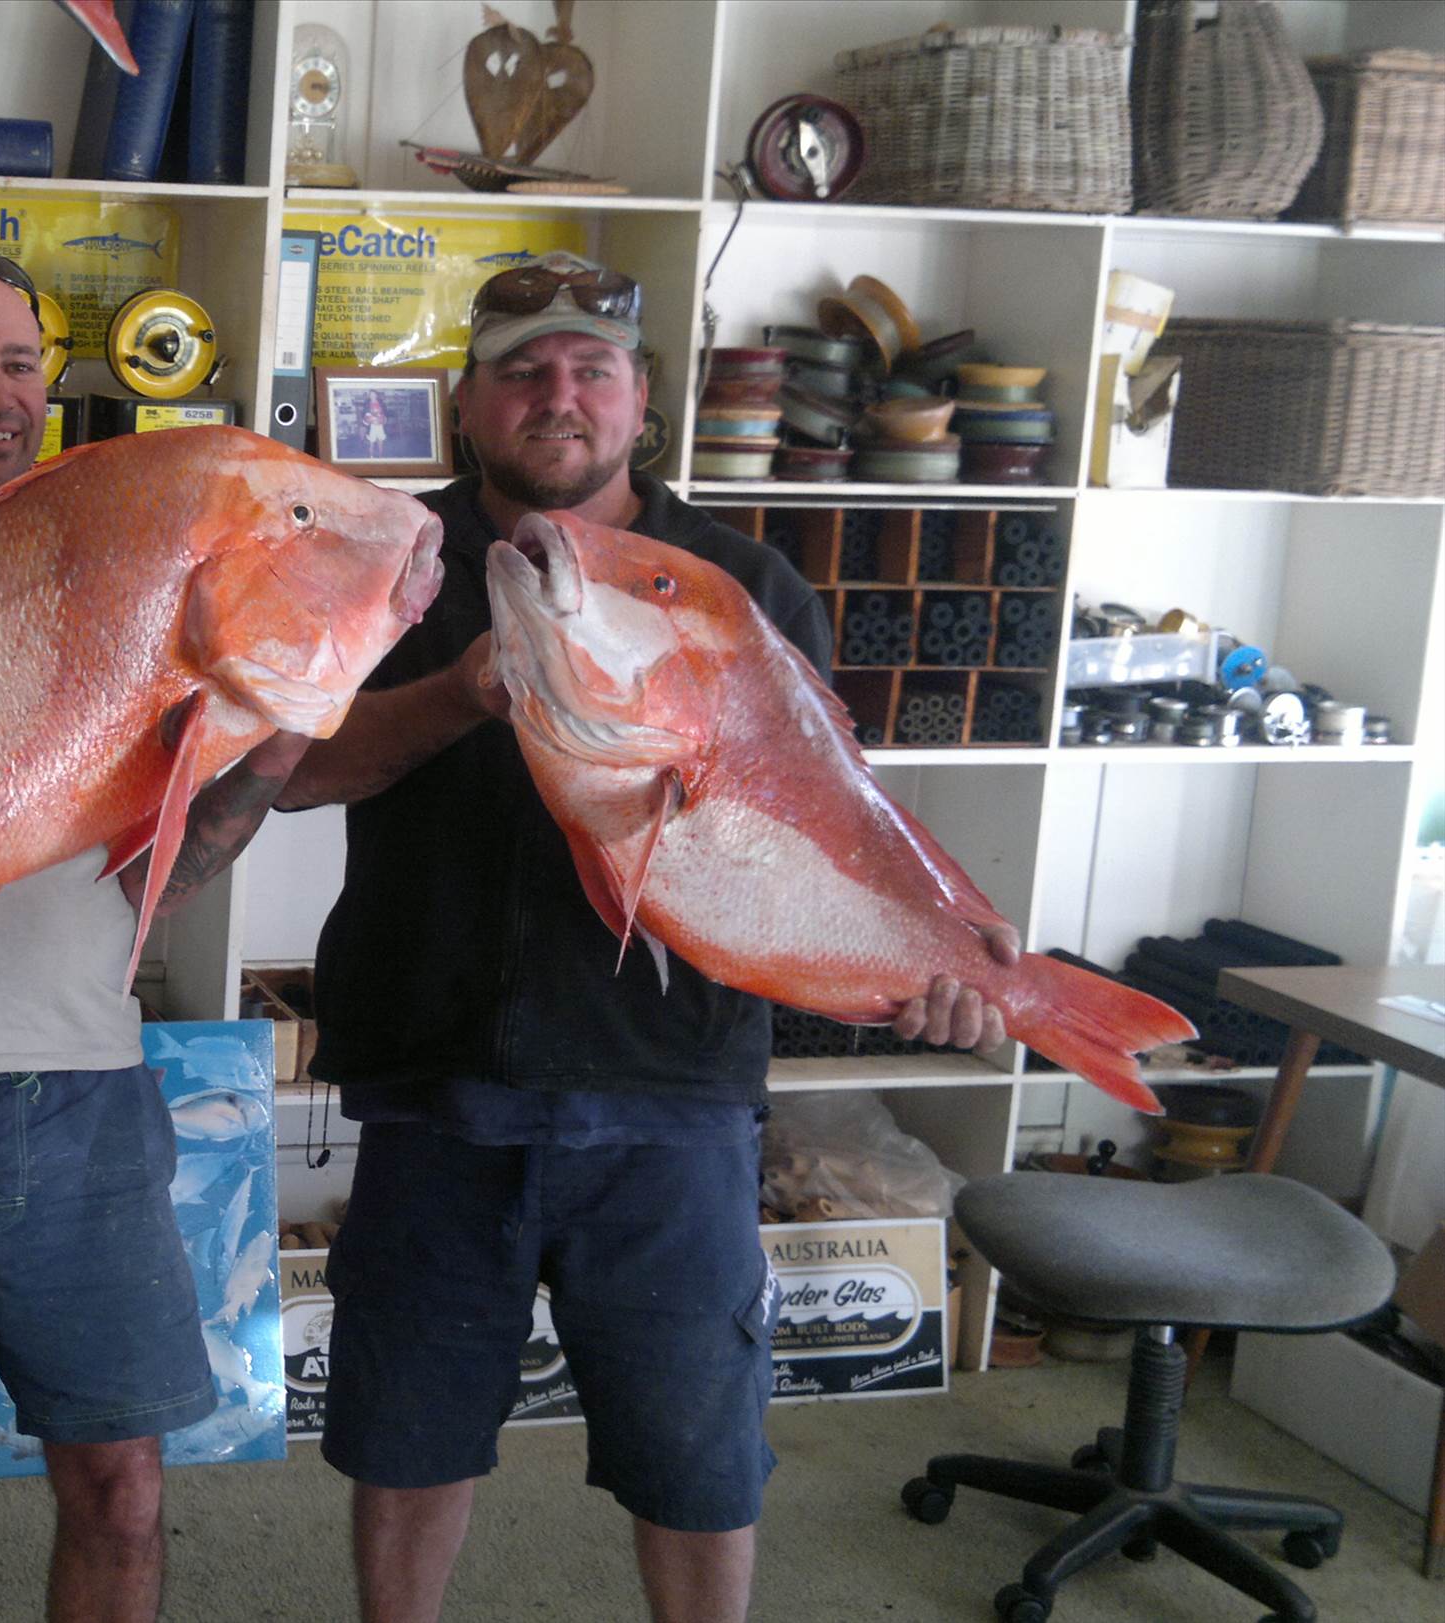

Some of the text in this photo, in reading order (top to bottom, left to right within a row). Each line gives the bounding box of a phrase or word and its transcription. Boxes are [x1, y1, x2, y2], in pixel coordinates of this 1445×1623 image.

[83, 240, 131, 251] WILSON
[319, 224, 436, 258] eCatch
[321, 262, 354, 271] SERIES
[359, 263, 402, 272] SPINNING
[325, 287, 426, 296] STEEL BALL BEARINGS
[337, 305, 371, 313] SYSTEM
[318, 314, 353, 322] TEFLON
[321, 332, 357, 341] QUALITY
[321, 342, 374, 350] TREATMENT
[771, 1239, 888, 1261] AUSTRALIA
[292, 1270, 327, 1289] MA
[834, 1280, 886, 1307] Glas
[797, 1323, 828, 1334] BUILT
[835, 1321, 867, 1332] RODS
[859, 1333, 891, 1342] BLANKS
[872, 1363, 891, 1377] than
[893, 1356, 909, 1373] just
[290, 1396, 315, 1411] Rods
